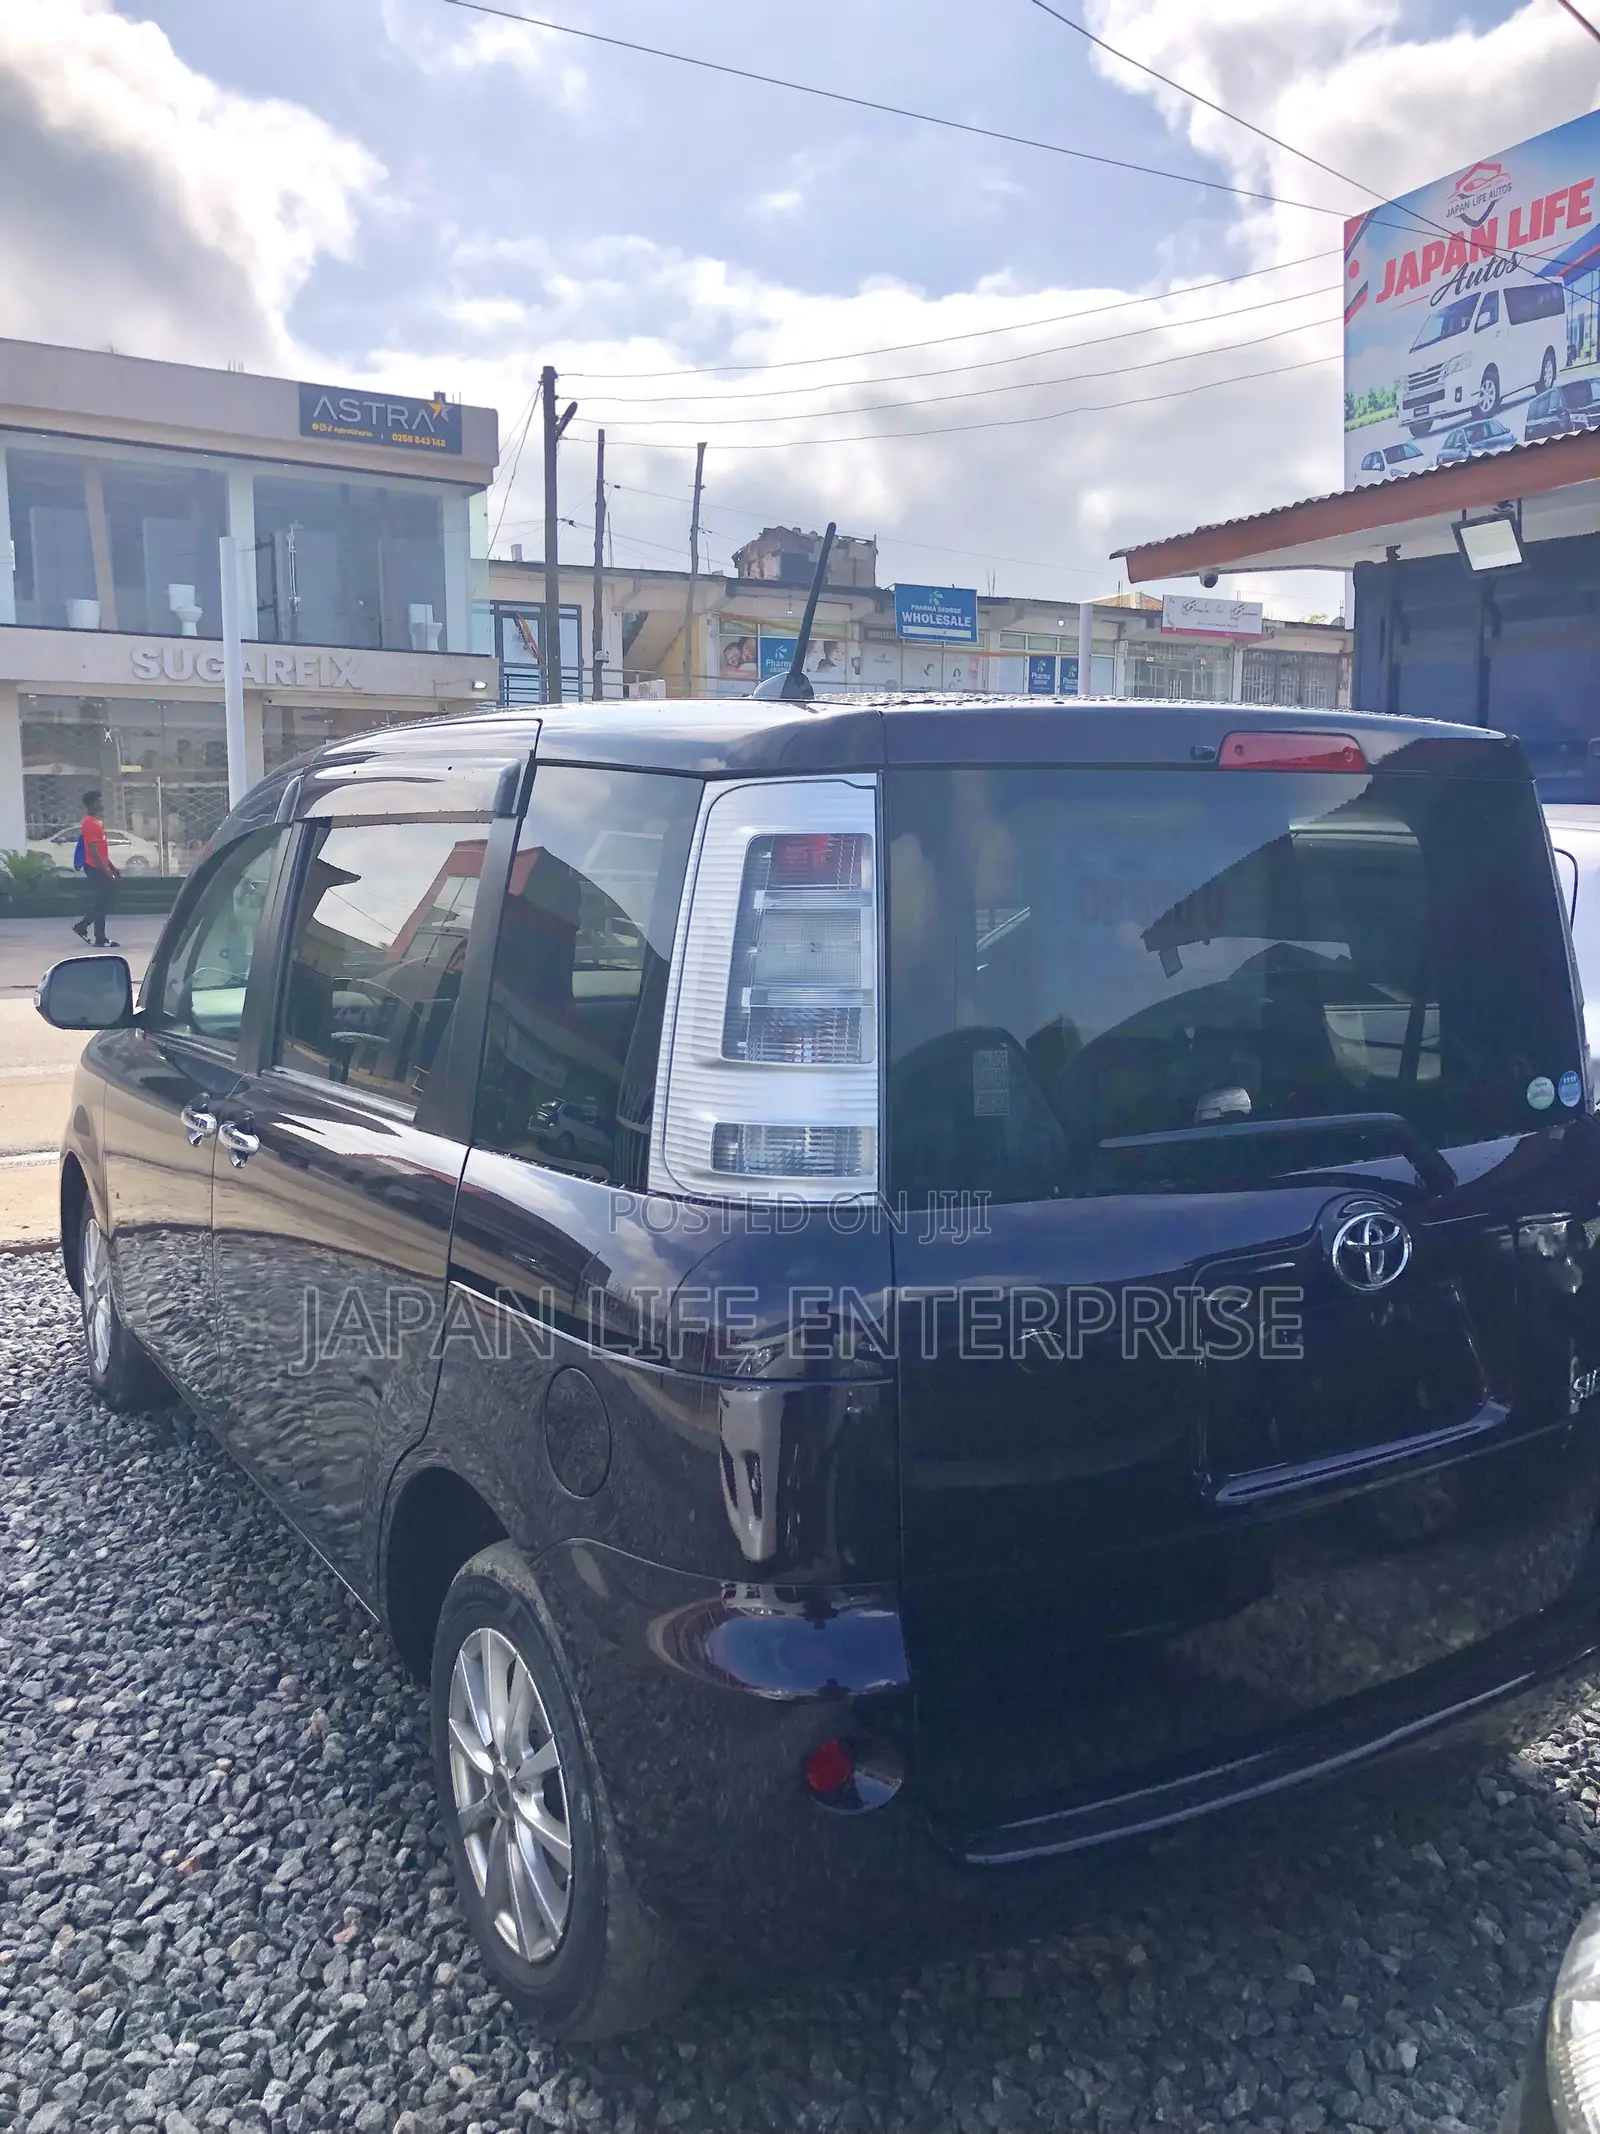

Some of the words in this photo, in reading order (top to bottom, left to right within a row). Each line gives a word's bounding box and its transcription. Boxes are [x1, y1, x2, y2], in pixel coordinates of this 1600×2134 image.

[1446, 200, 1470, 218] JAPAN
[1472, 192, 1488, 207] LIFE
[1488, 182, 1513, 200] AUTOS
[1375, 217, 1499, 304] JAPAN
[1507, 177, 1596, 251] LIFE
[1430, 251, 1525, 307] Autos
[312, 395, 435, 433] ASTRA
[902, 611, 972, 627] WHOLESALE
[911, 604, 937, 612] PHARMA
[937, 606, 962, 614] GEORGE
[132, 646, 363, 689] SUGARFIX
[765, 659, 792, 668] Pharm
